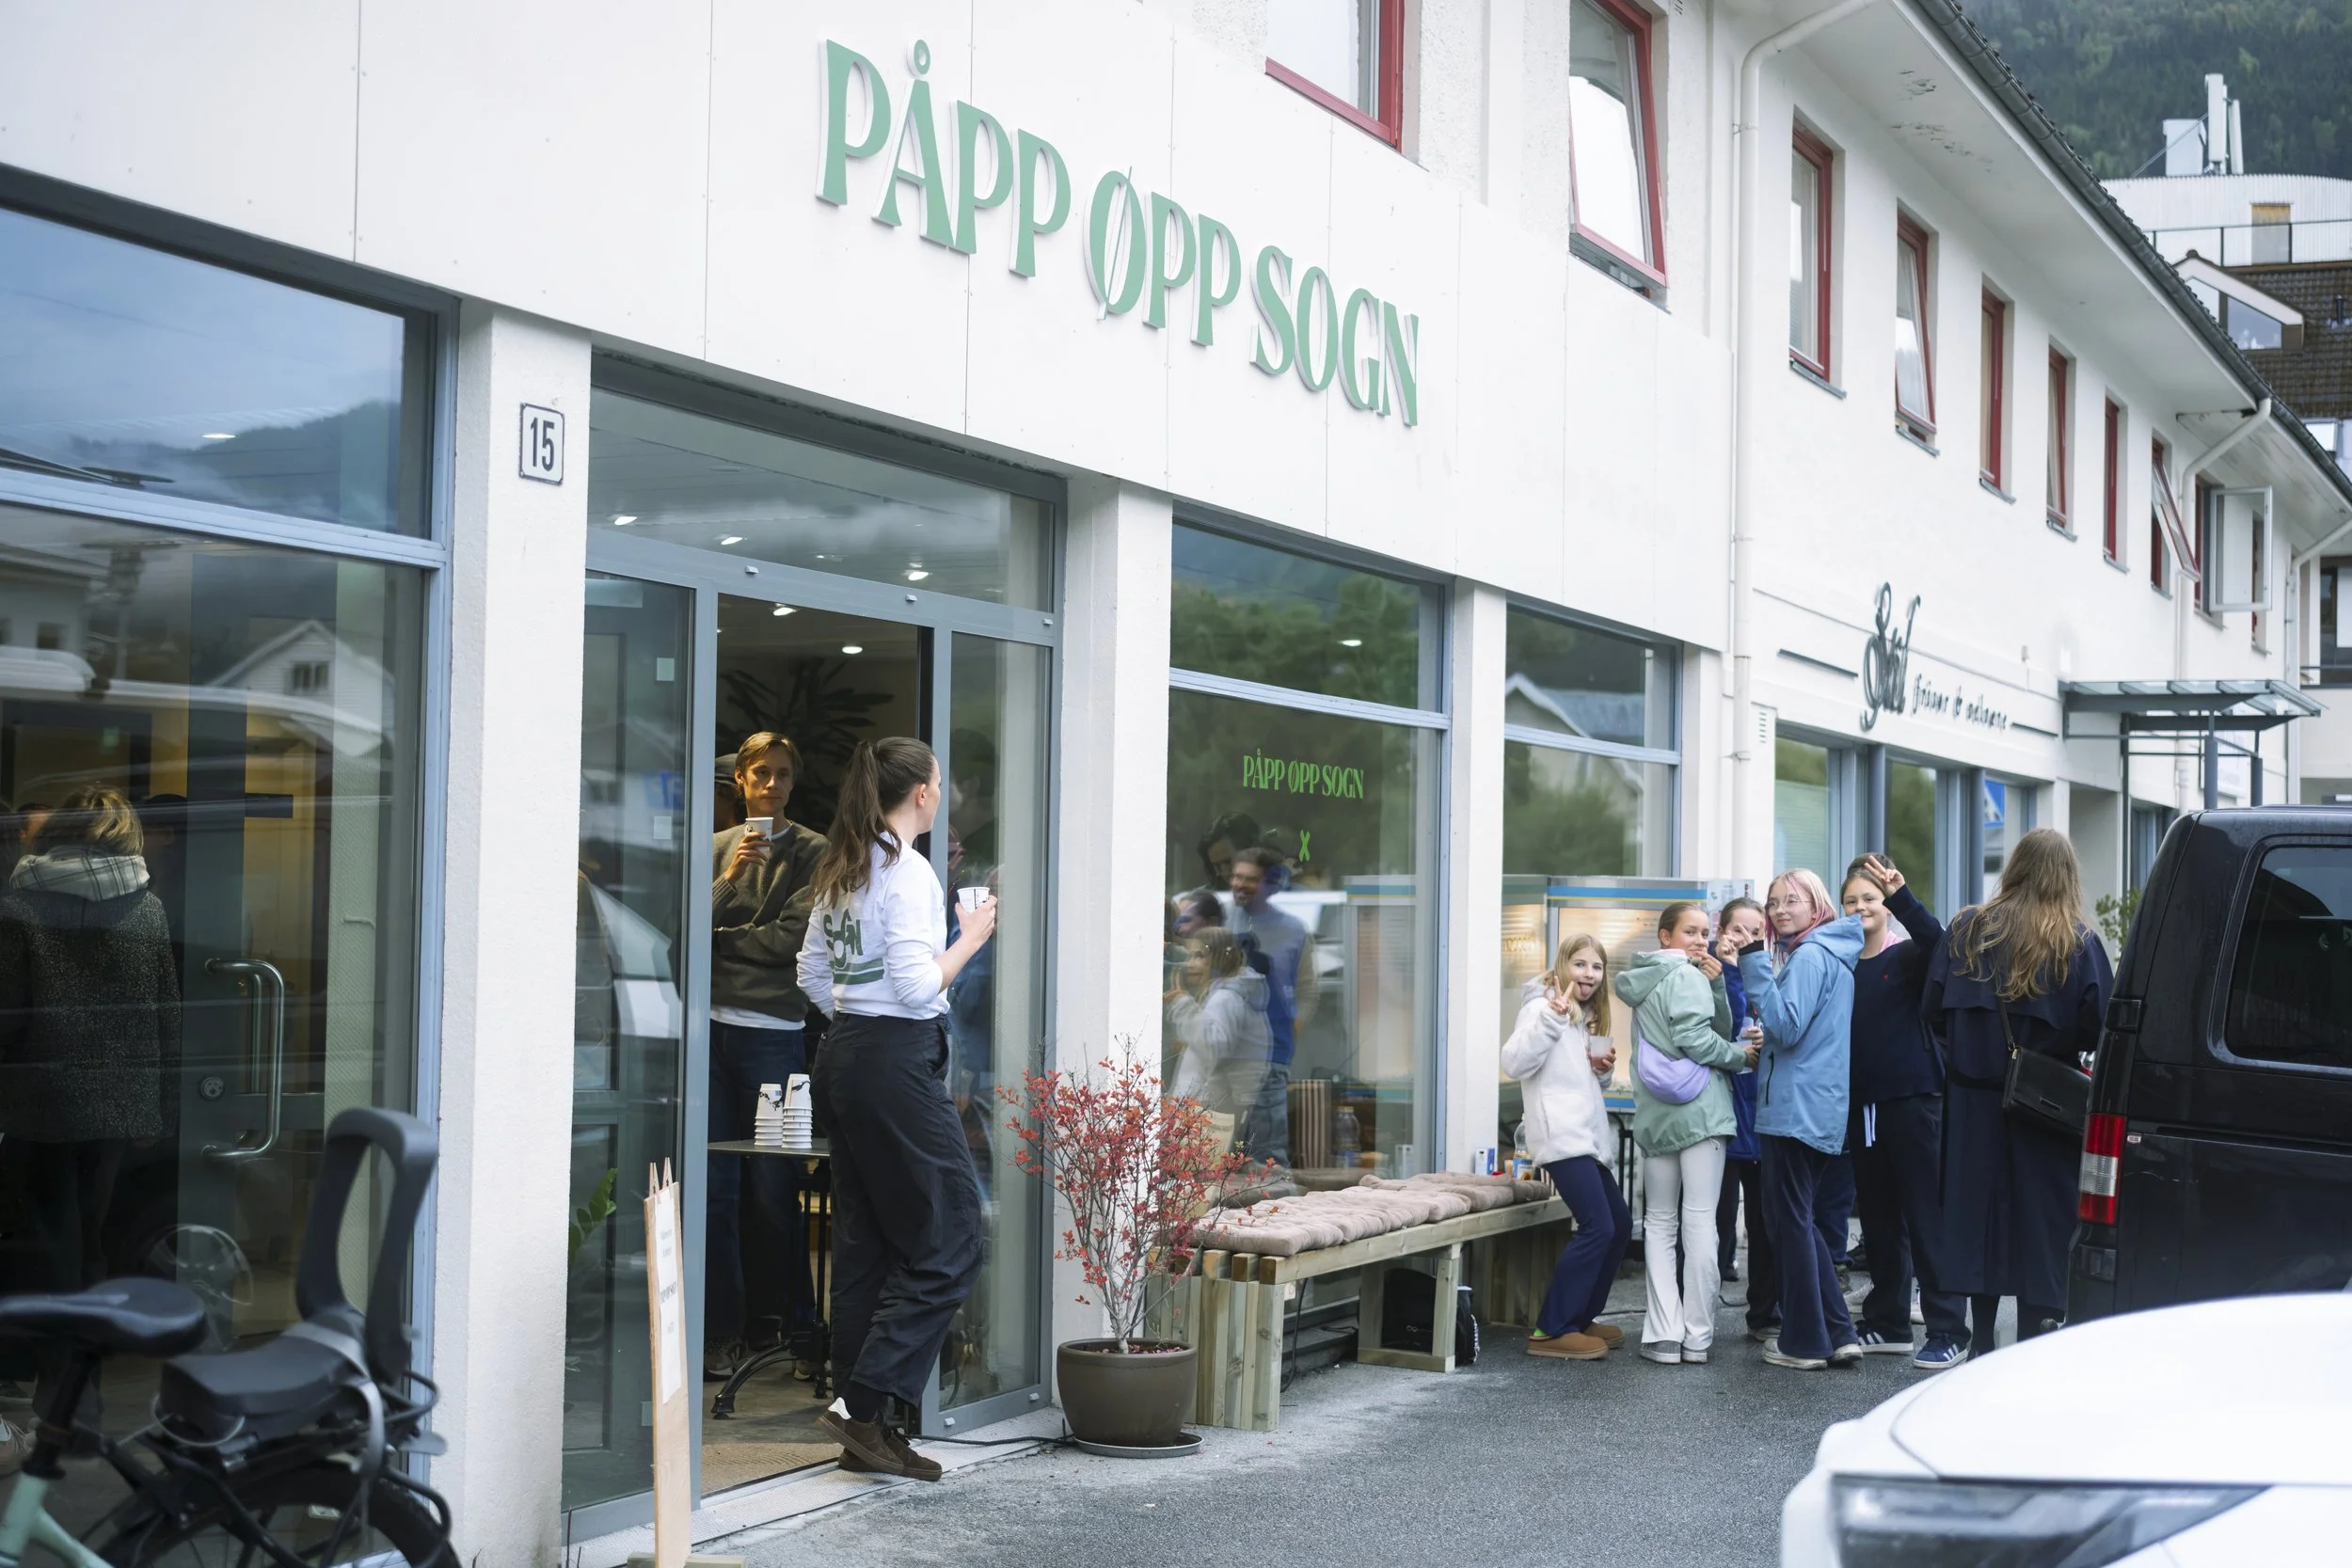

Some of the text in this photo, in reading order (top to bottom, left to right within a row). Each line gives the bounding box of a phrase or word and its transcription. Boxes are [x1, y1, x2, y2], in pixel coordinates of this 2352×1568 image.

[817, 39, 1418, 426] PÅPP ØPP SOGN
[530, 417, 555, 472] 15
[1243, 748, 1364, 799] PÅPP ØPP SOGN
